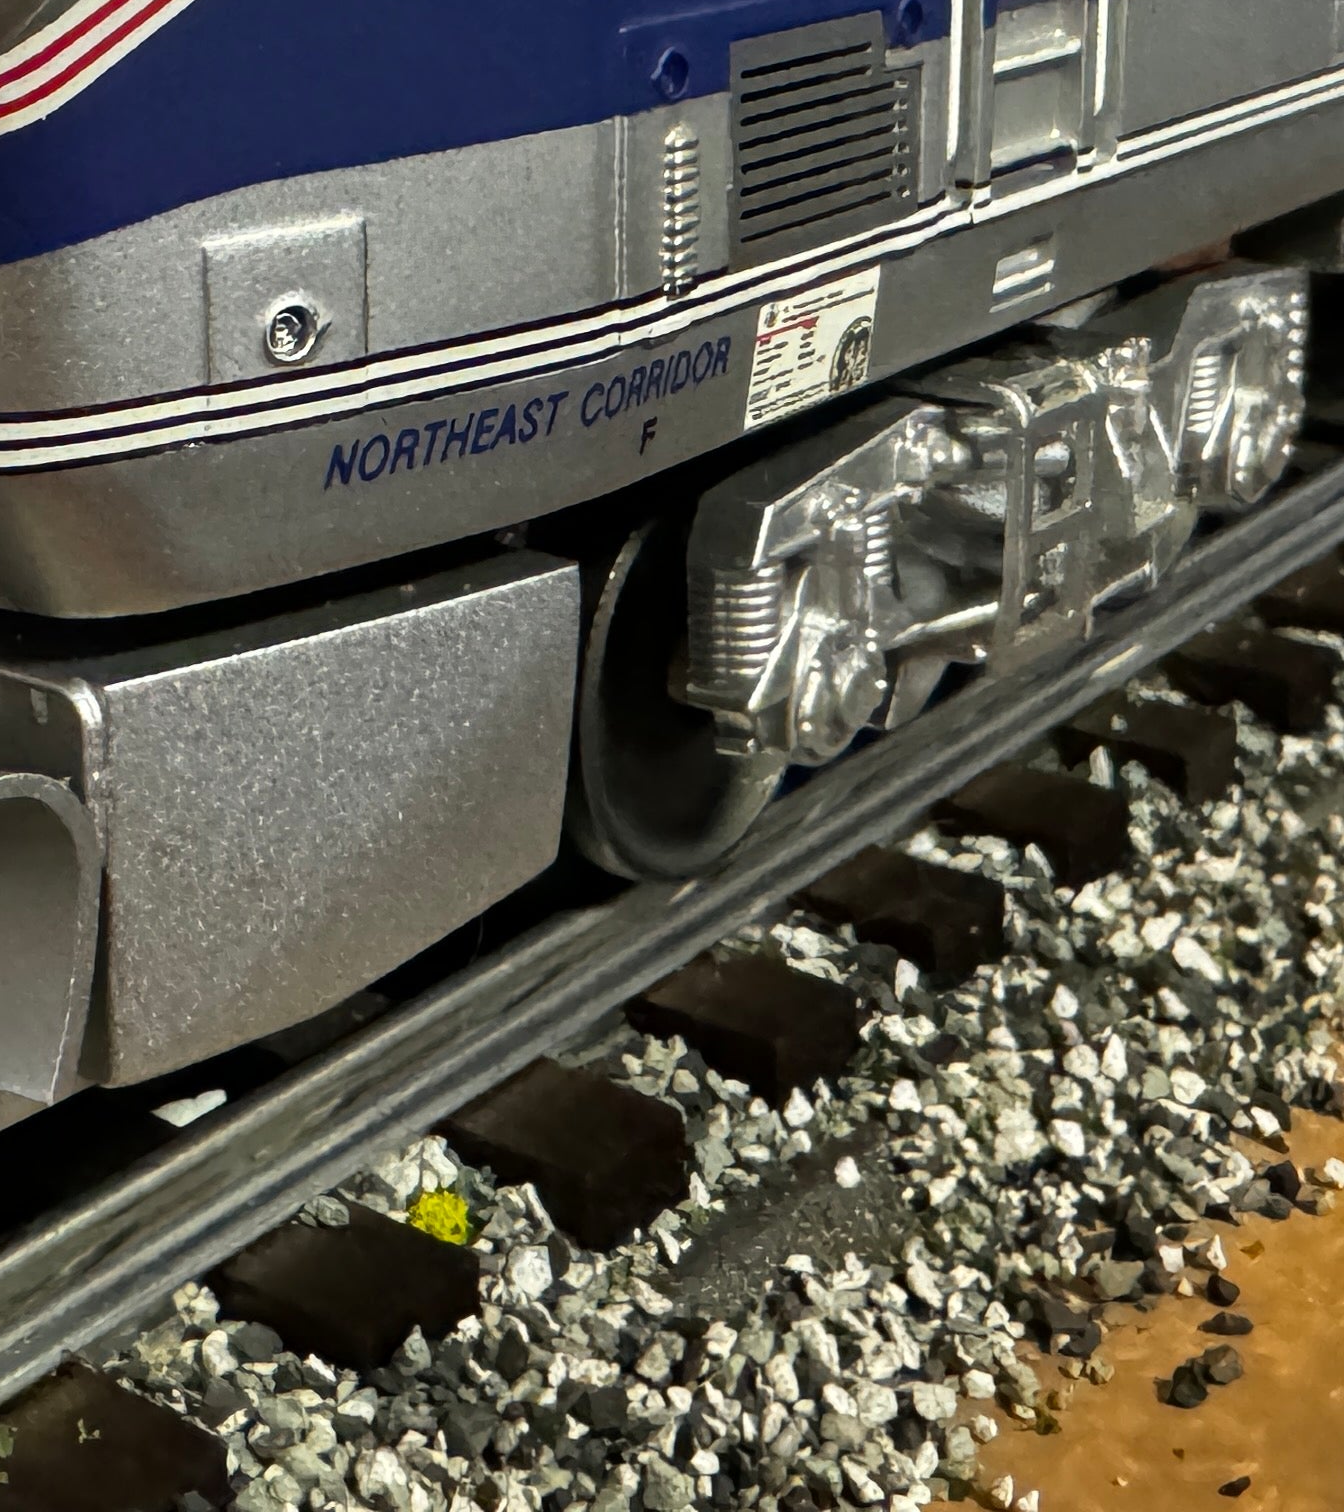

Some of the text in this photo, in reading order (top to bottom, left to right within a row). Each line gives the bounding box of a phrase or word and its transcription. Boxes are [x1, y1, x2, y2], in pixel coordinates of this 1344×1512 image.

[324, 392, 570, 490] NORTHEAST
[580, 336, 732, 427] CORRIDOR
[638, 417, 658, 456] F
